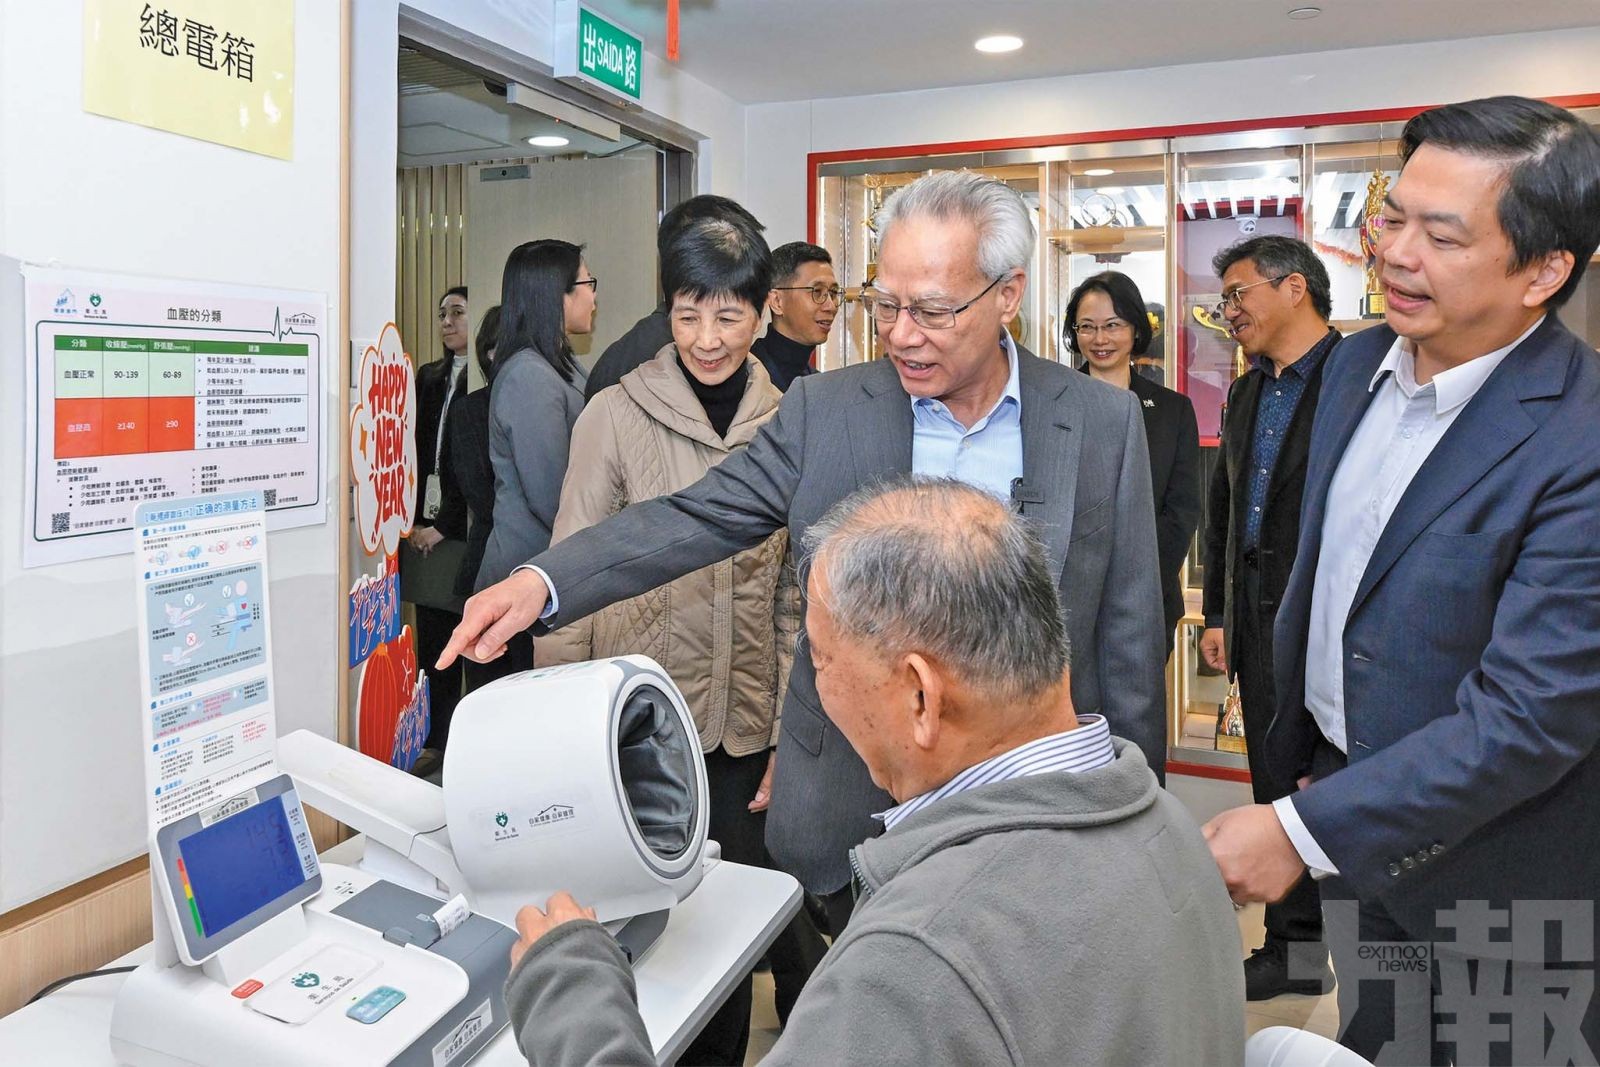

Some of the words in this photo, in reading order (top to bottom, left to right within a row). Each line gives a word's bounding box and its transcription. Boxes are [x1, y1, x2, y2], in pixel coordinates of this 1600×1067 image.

[139, 3, 255, 83] 總電箱
[583, 23, 597, 72] 出
[597, 38, 624, 77] SAÍDA
[624, 44, 637, 91] 路
[167, 307, 222, 323] 血壓的分類
[64, 370, 95, 379] 血壓正常
[113, 370, 139, 379] 90-139
[162, 371, 182, 379] 60-89
[368, 362, 409, 420] HAPPY
[67, 423, 91, 433] 血壓高
[117, 422, 136, 430] ≥140
[166, 420, 178, 428] ≥90
[375, 415, 406, 470] NEW
[373, 463, 408, 536] YEAR
